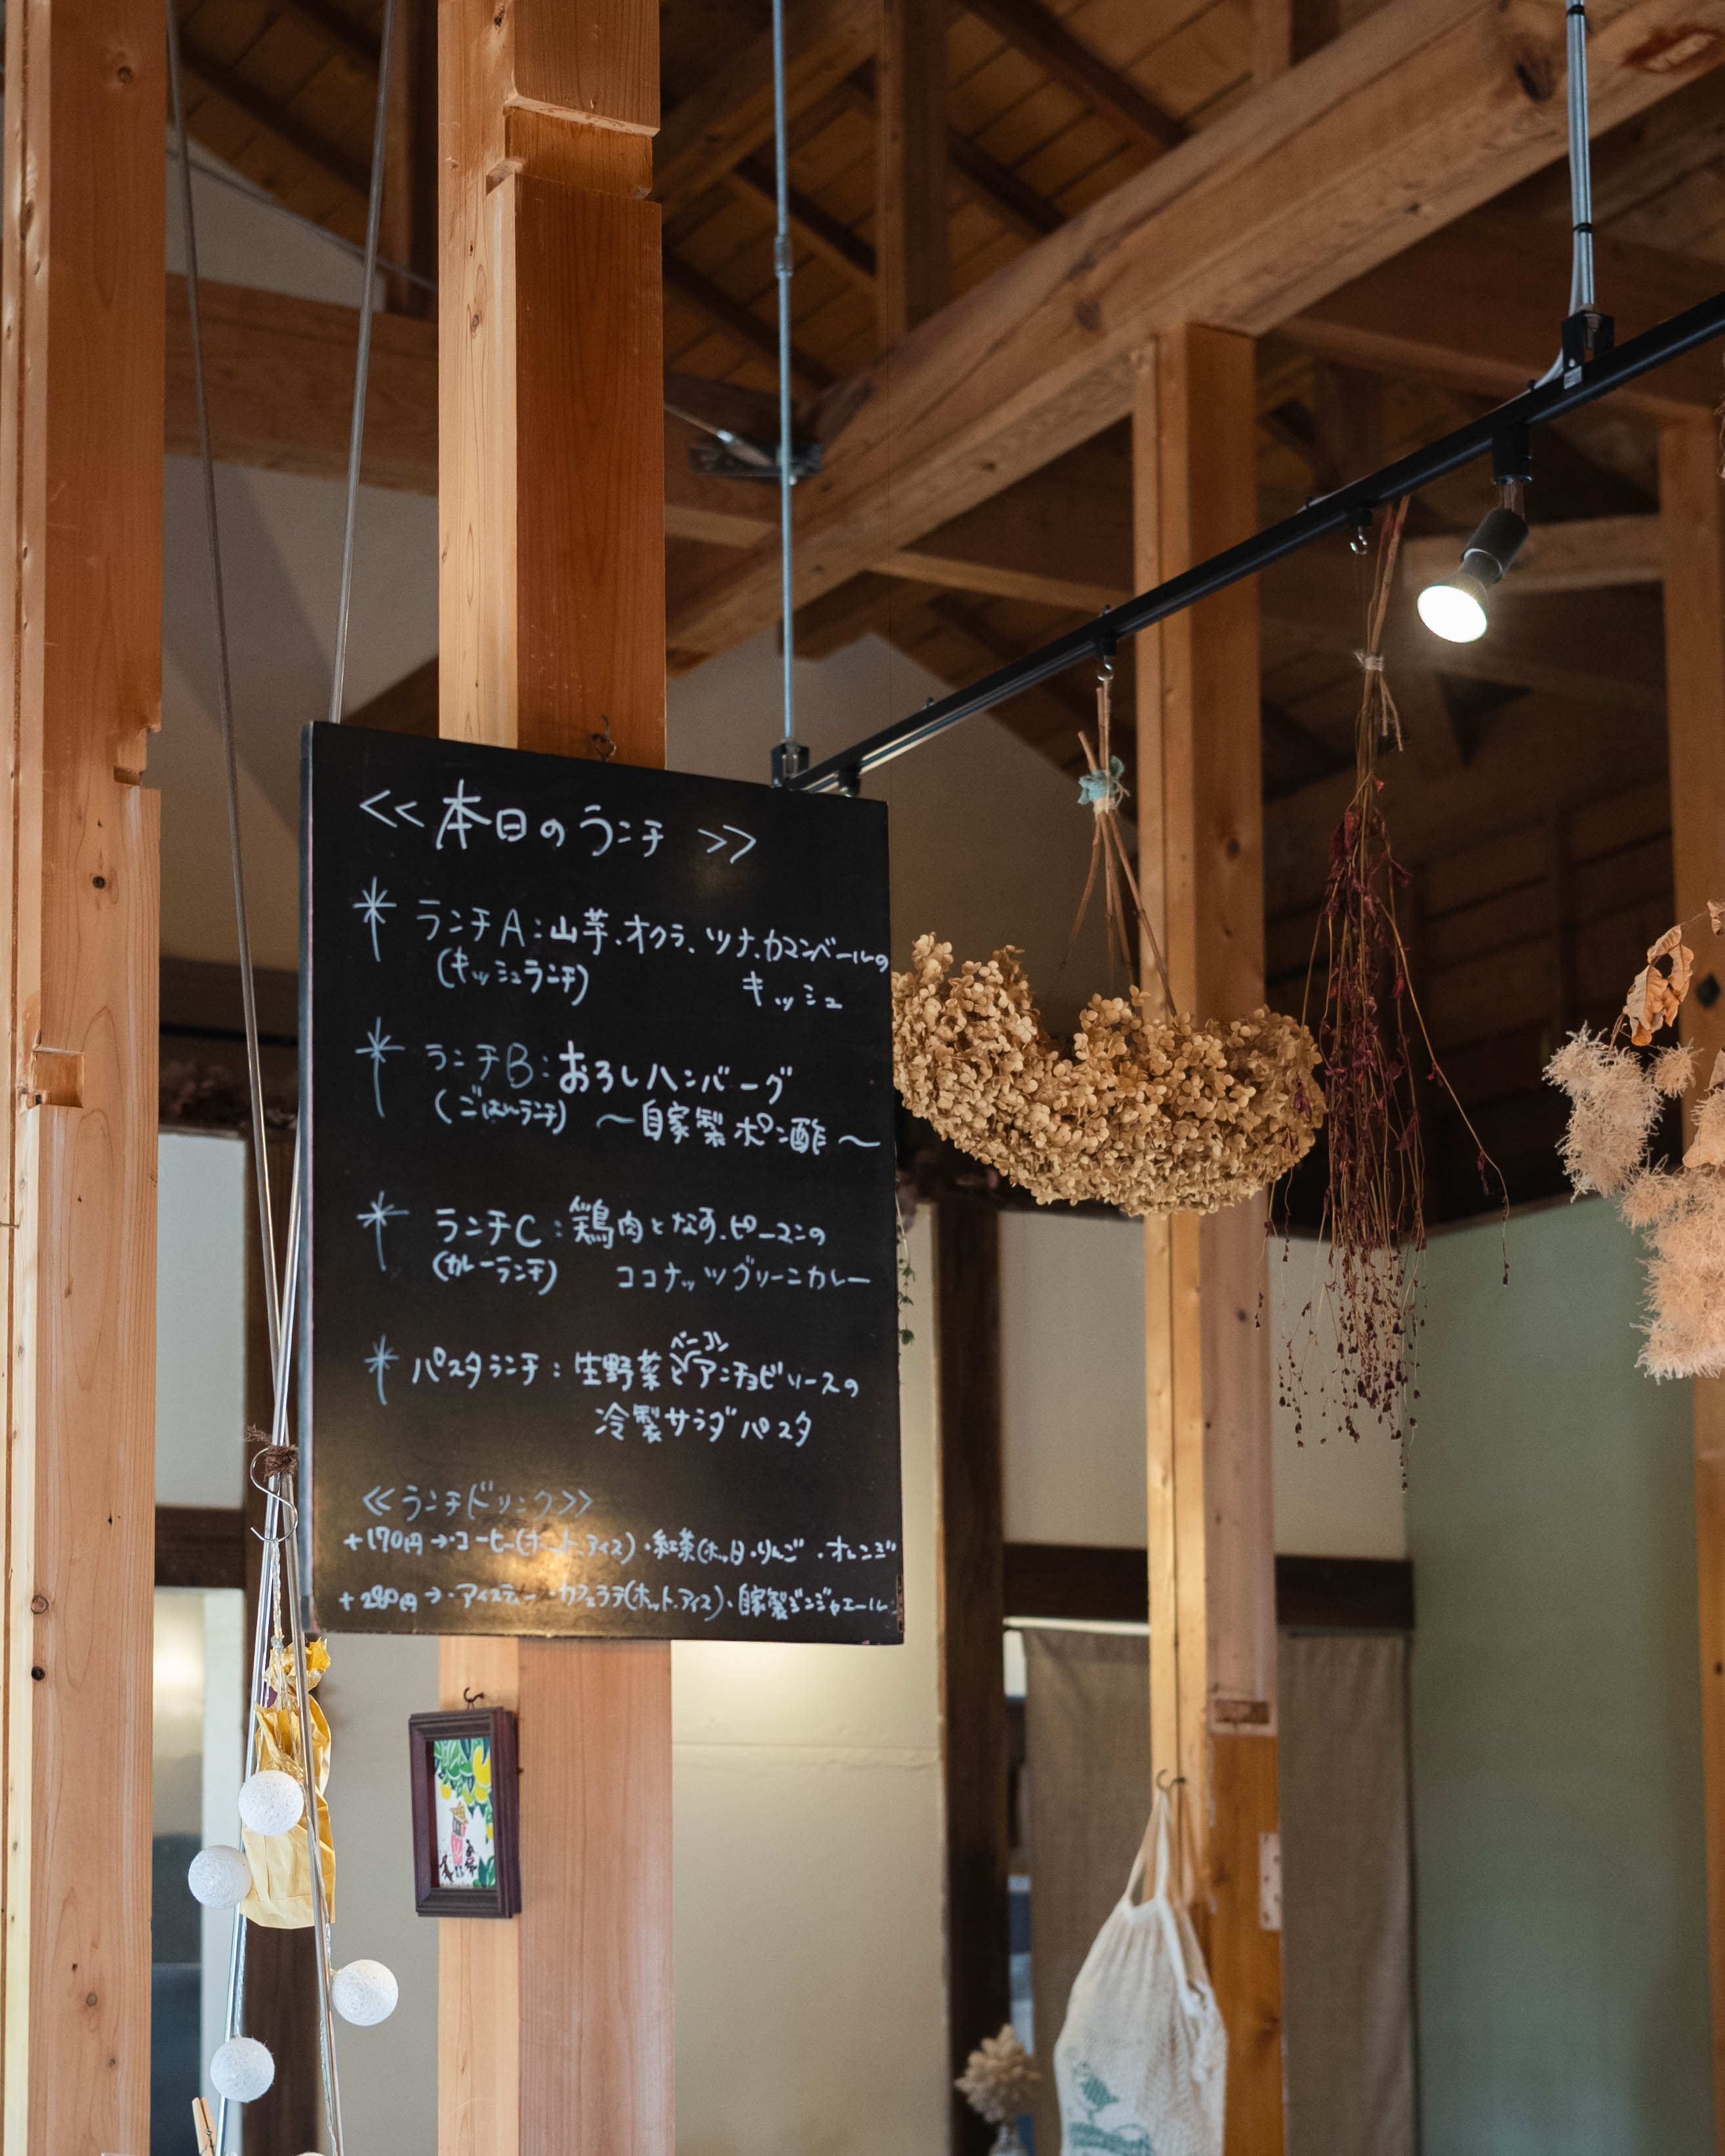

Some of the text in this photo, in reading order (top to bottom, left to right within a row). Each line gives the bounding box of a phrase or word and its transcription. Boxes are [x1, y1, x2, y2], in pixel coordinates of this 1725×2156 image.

[742, 971, 843, 1011] キッシュ
[594, 1401, 812, 1447] 冷製サラダパスタ
